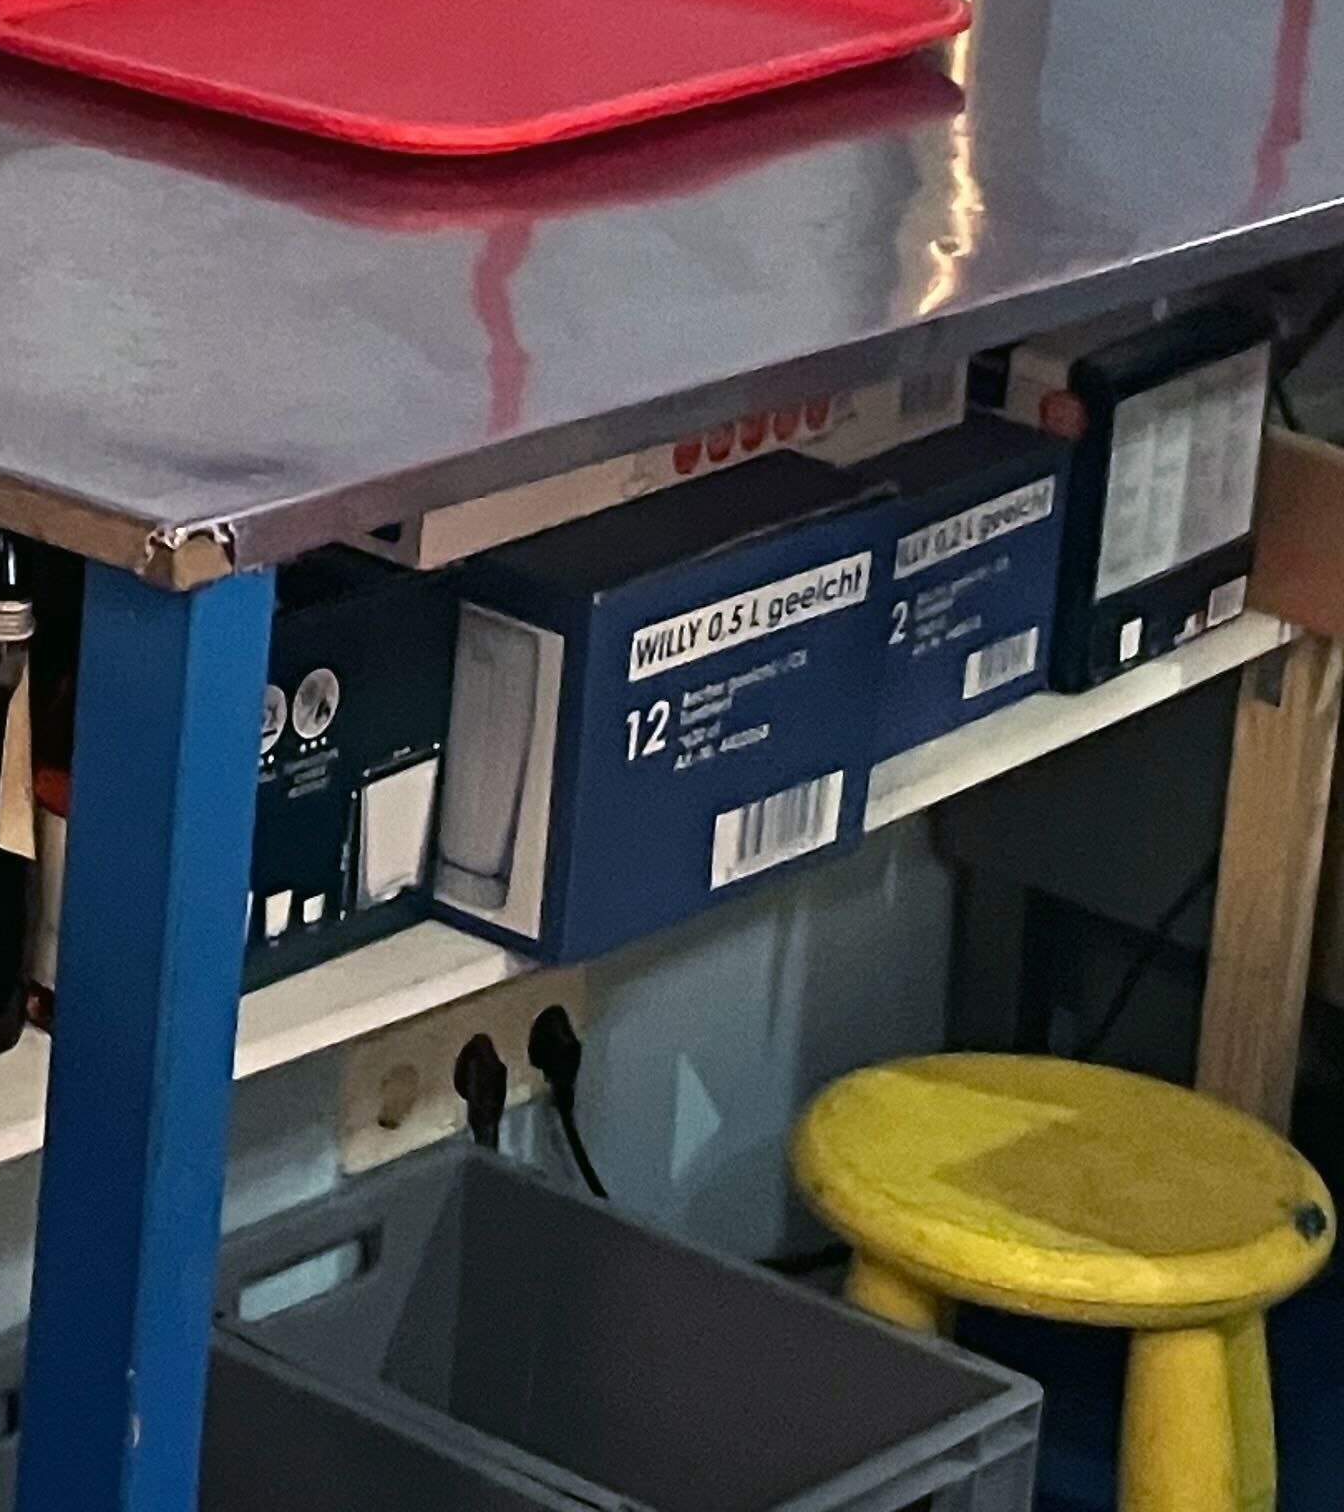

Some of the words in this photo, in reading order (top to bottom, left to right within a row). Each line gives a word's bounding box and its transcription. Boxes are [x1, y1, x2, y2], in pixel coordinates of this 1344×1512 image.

[635, 617, 703, 669] WILLY
[749, 598, 760, 628] L
[625, 698, 671, 762] 12
